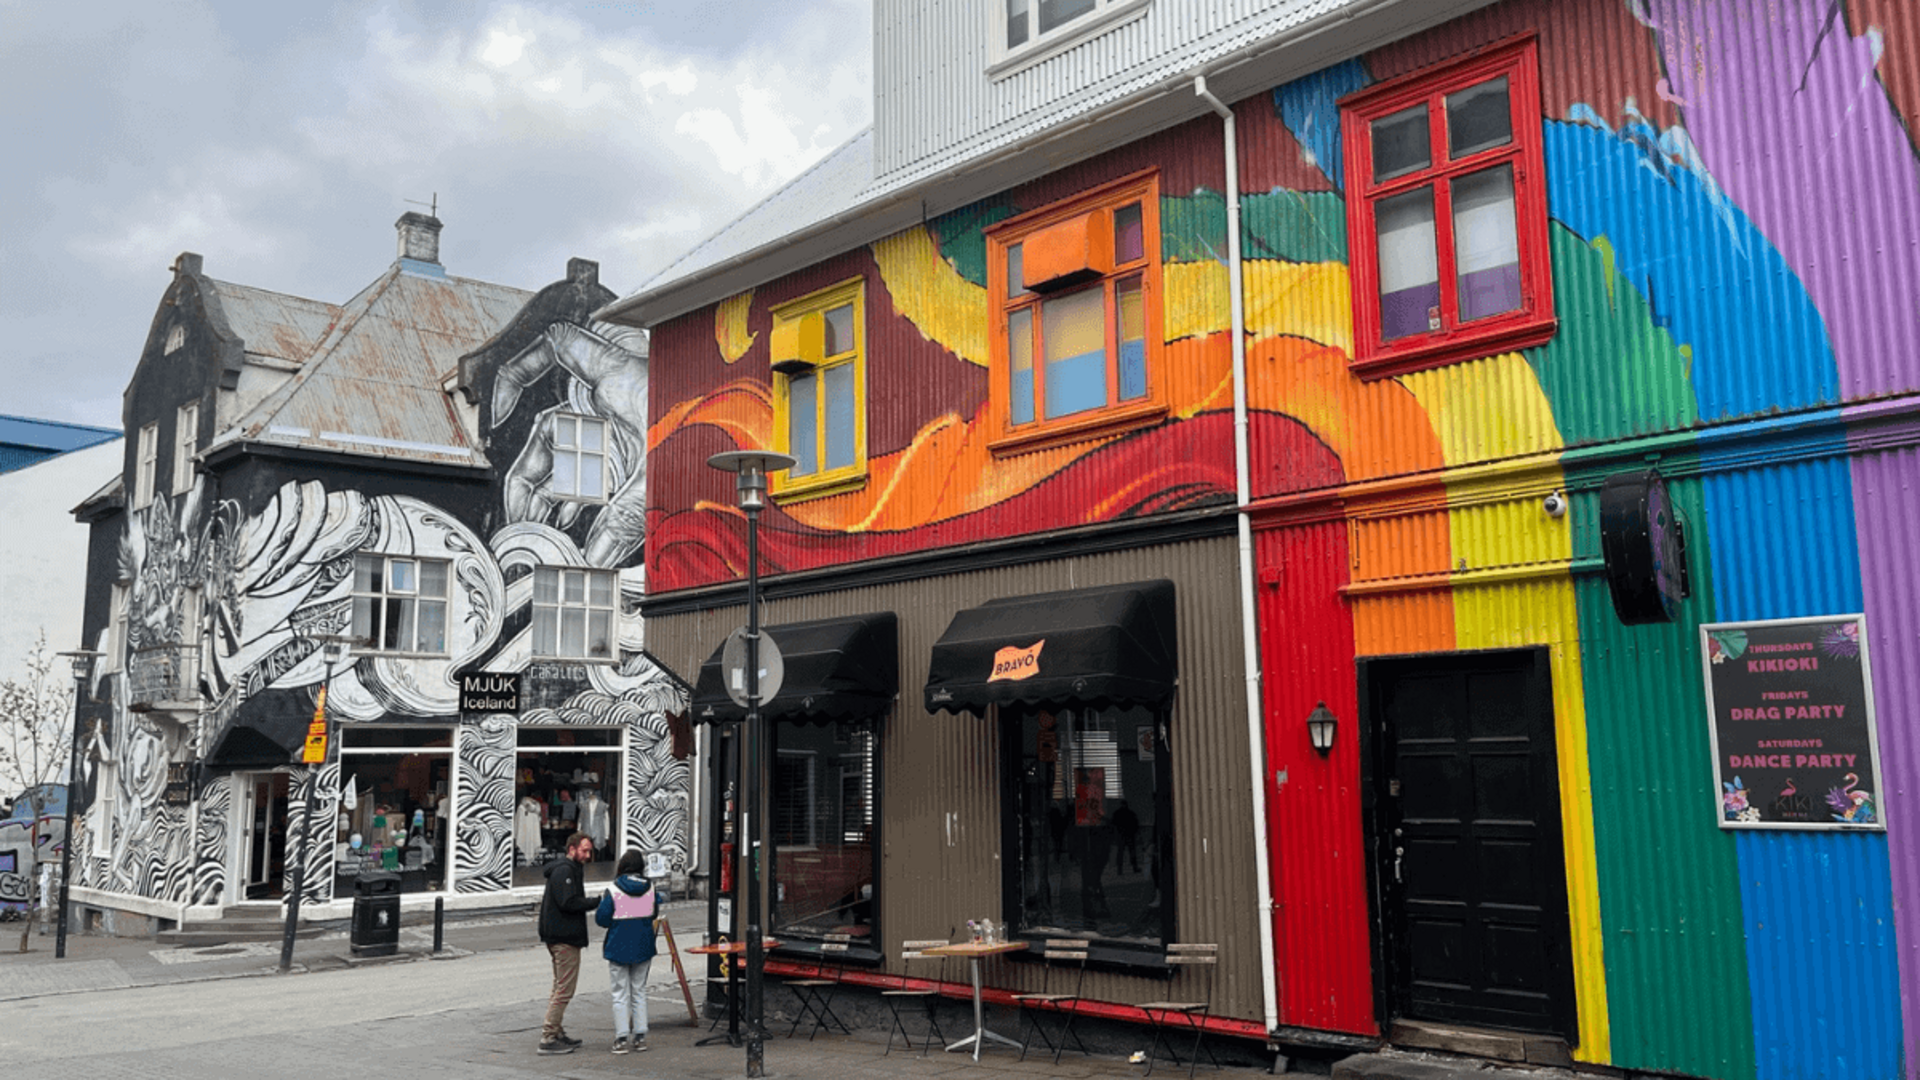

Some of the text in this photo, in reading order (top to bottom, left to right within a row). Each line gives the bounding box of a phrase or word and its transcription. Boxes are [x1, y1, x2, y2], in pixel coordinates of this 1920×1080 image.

[1748, 642, 1814, 654] THURSDAYS
[1747, 657, 1818, 673] KIKIOKI
[464, 674, 516, 693] MJÚK
[464, 695, 516, 710] Iceland
[1761, 691, 1809, 700] FRIDAYS
[1730, 705, 1845, 721] DRAG PARTY
[1757, 739, 1823, 748] SATURDAYS
[1729, 754, 1857, 768] DANCE PARTY
[1775, 796, 1814, 810] KIKI
